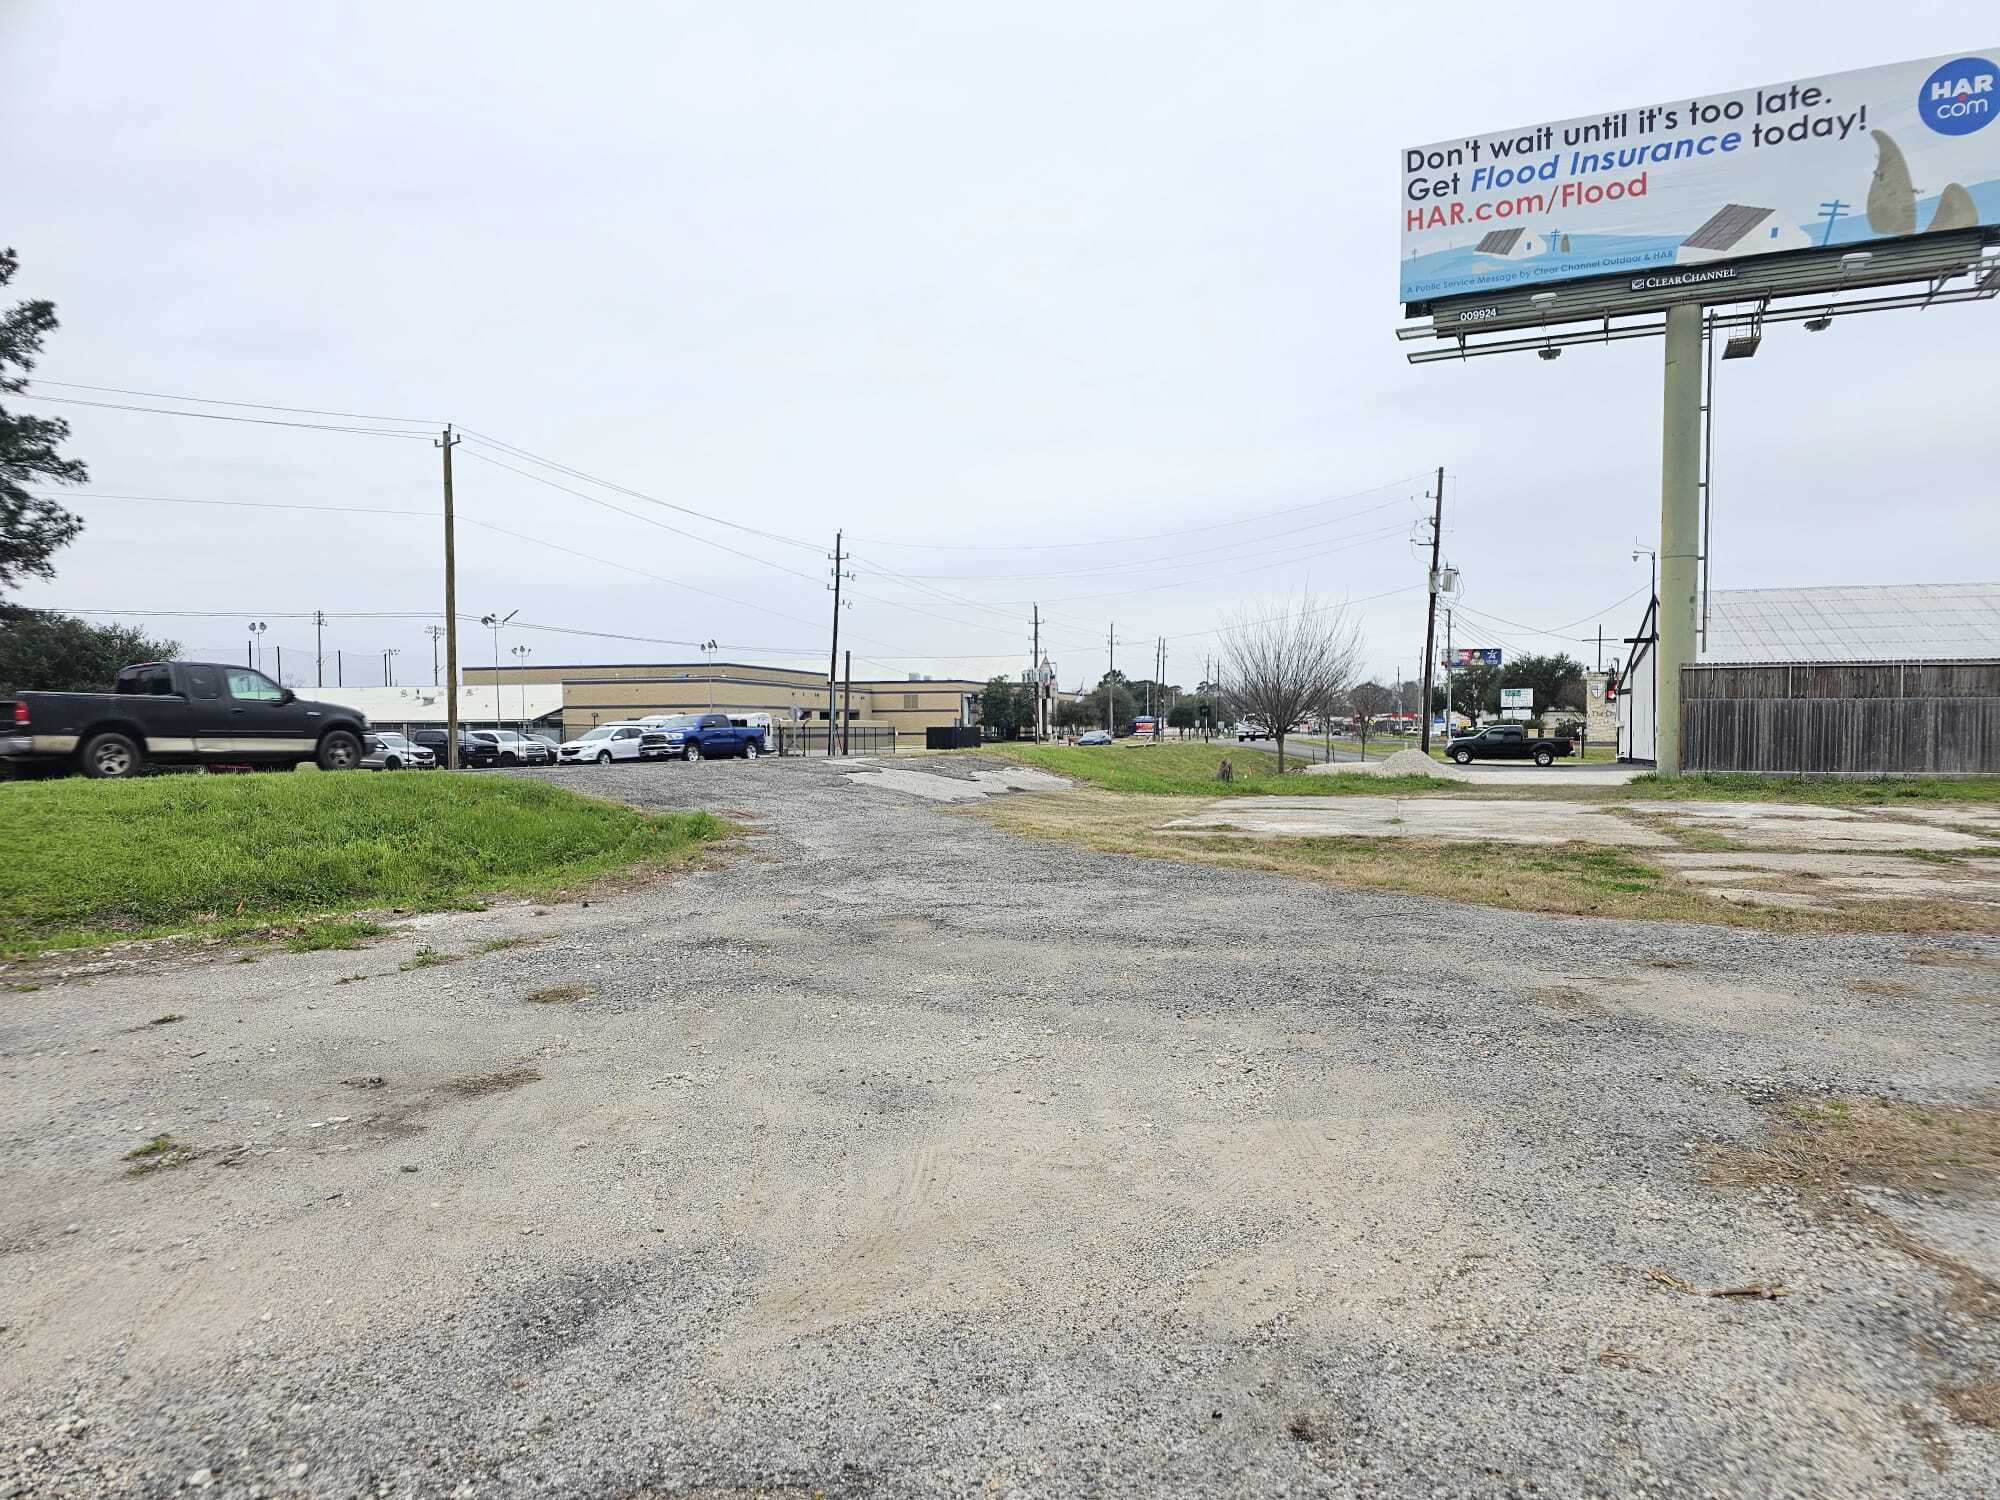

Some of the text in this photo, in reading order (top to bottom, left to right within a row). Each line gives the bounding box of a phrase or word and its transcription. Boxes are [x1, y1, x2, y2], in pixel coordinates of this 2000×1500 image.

[1931, 74, 1994, 100] HAR
[1407, 84, 1832, 173] Don't wait until it's too late.
[1407, 104, 1867, 201] Get Flood Insurance today!
[1407, 171, 1648, 232] HAR.com/Flood
[1415, 281, 1441, 293] Public
[1443, 279, 1475, 289] Service
[1477, 271, 1518, 284] Message
[1519, 269, 1531, 279] by
[1533, 265, 1559, 276] Clear
[1560, 260, 1600, 272] Channel
[1602, 254, 1642, 266] Outdoor
[1653, 250, 1674, 260] HAR
[1460, 308, 1498, 321] 009924
